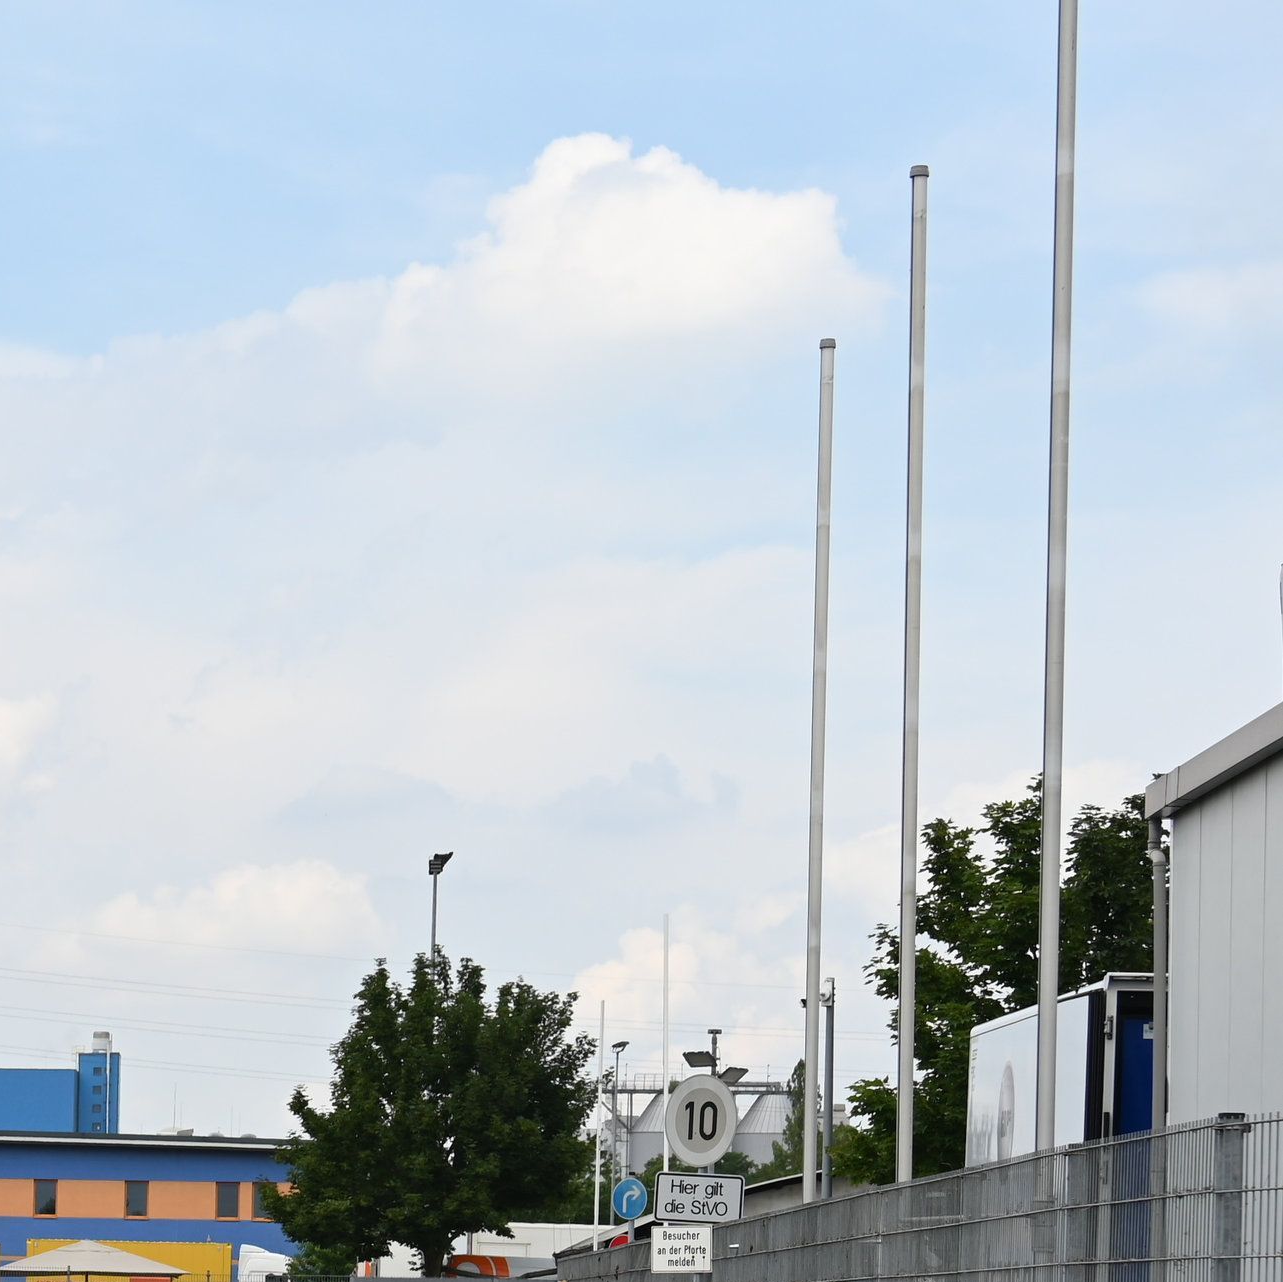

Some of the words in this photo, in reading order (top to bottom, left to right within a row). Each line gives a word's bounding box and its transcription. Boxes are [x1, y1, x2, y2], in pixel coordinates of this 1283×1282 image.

[684, 1101, 718, 1141] 10
[670, 1179, 699, 1195] Hier
[704, 1181, 724, 1200] gilt
[664, 1199, 685, 1214] die
[690, 1200, 728, 1217] StVO
[662, 1231, 700, 1241] Besucher
[657, 1247, 667, 1255] an
[669, 1245, 682, 1255] der
[684, 1244, 707, 1255] Pforte
[667, 1257, 696, 1267] melden
